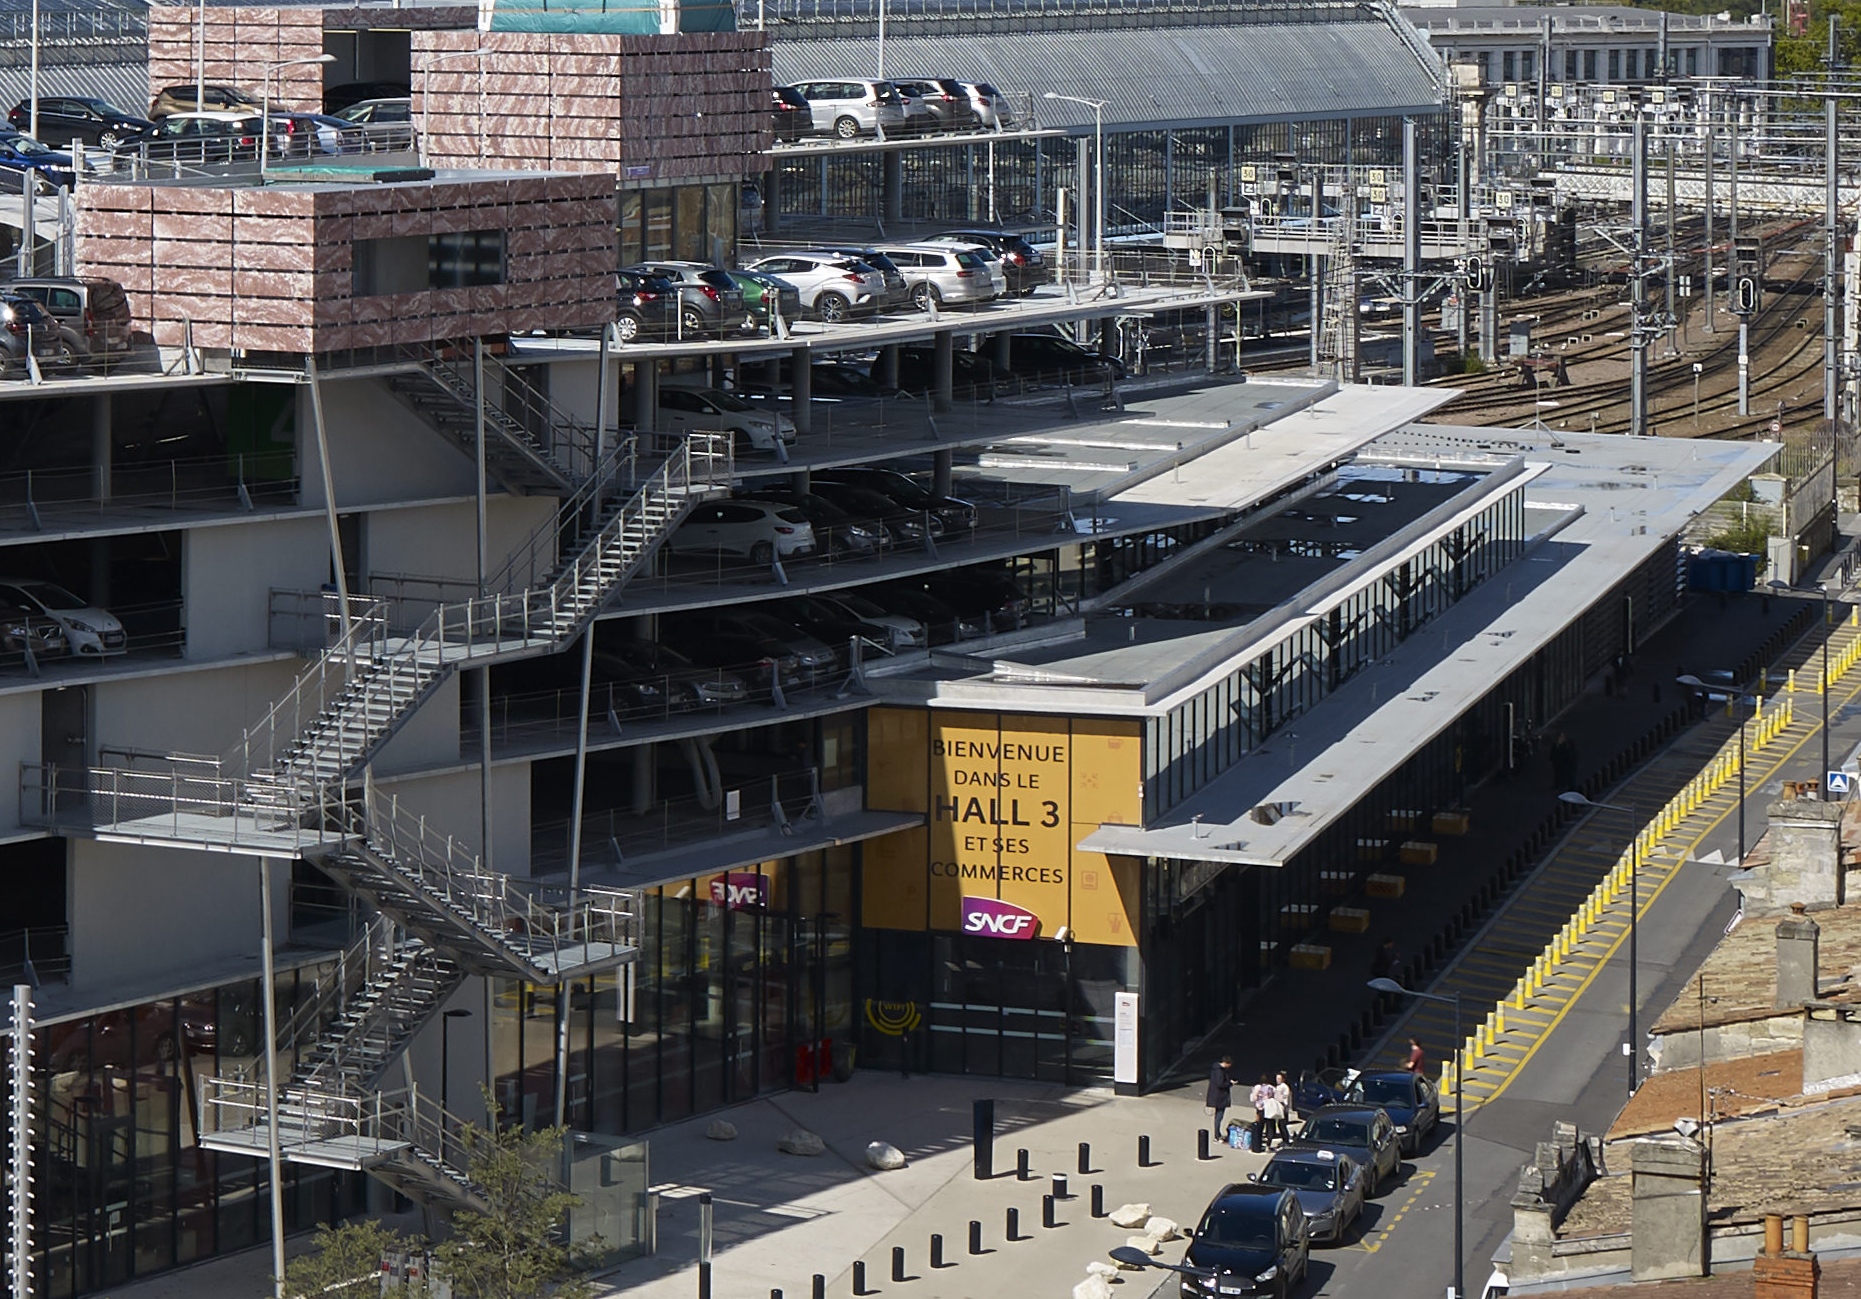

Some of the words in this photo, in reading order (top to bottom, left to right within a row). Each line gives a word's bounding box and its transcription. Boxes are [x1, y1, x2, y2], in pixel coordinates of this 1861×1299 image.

[933, 738, 1065, 763] BIENVENUE
[954, 769, 1011, 787] DANS
[1017, 773, 1040, 789] LE
[935, 795, 1030, 827] HALL
[1041, 800, 1060, 828] 3
[964, 836, 988, 852] ET
[992, 838, 1030, 854] SES
[930, 861, 1064, 883] COMMERCES
[964, 912, 1033, 934] SNCF
